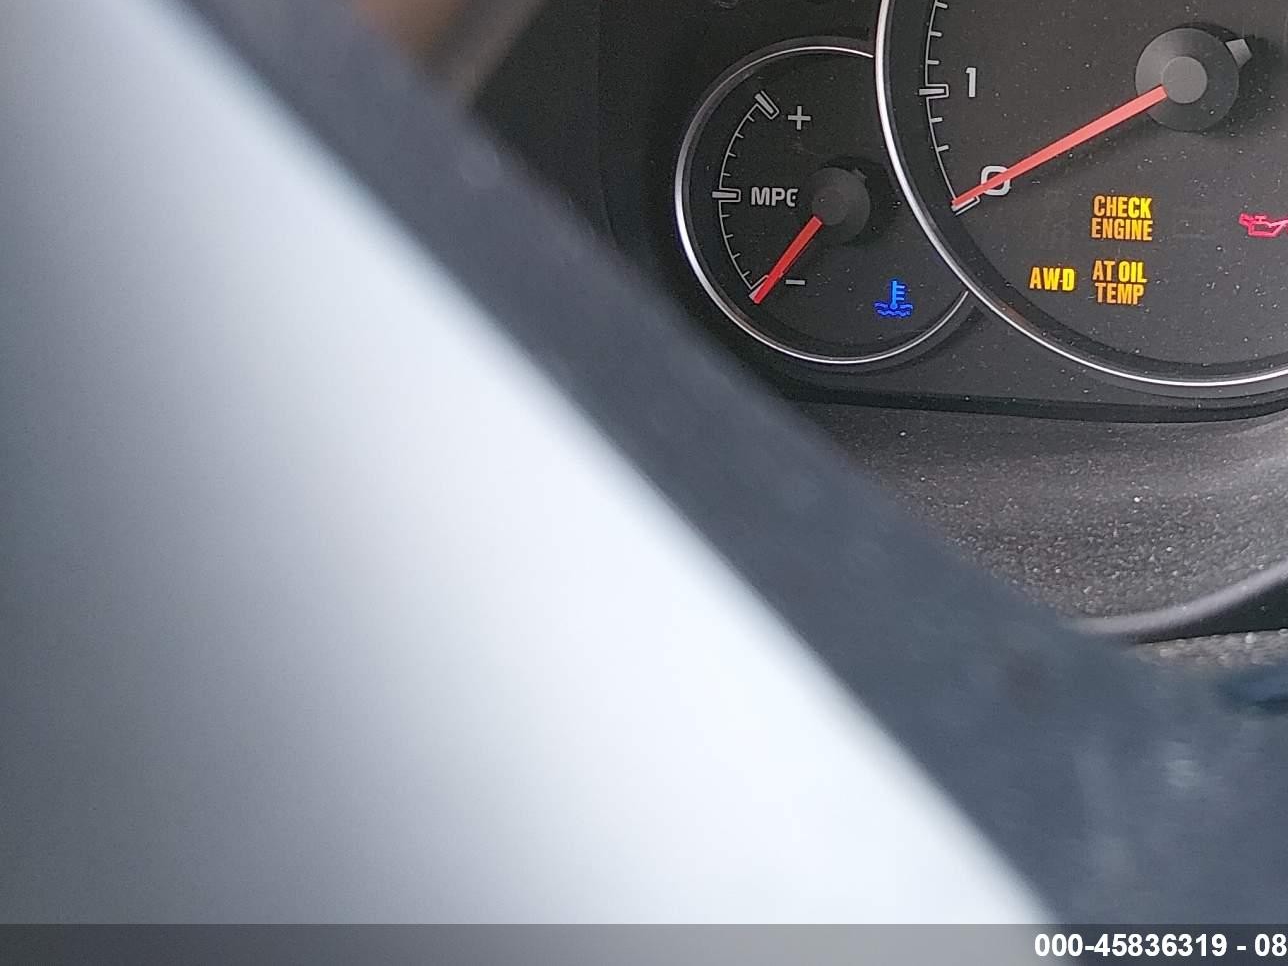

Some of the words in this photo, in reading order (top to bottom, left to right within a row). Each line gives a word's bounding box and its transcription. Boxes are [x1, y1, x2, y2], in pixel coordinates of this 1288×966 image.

[966, 67, 977, 98] 1
[981, 166, 1011, 196] 0
[1093, 196, 1153, 218] CHECK
[1091, 217, 1153, 241] ENGINE
[1029, 267, 1076, 292] AWD
[1092, 260, 1115, 282] AT
[1117, 261, 1148, 284] OIL
[1094, 282, 1145, 305] TEMP
